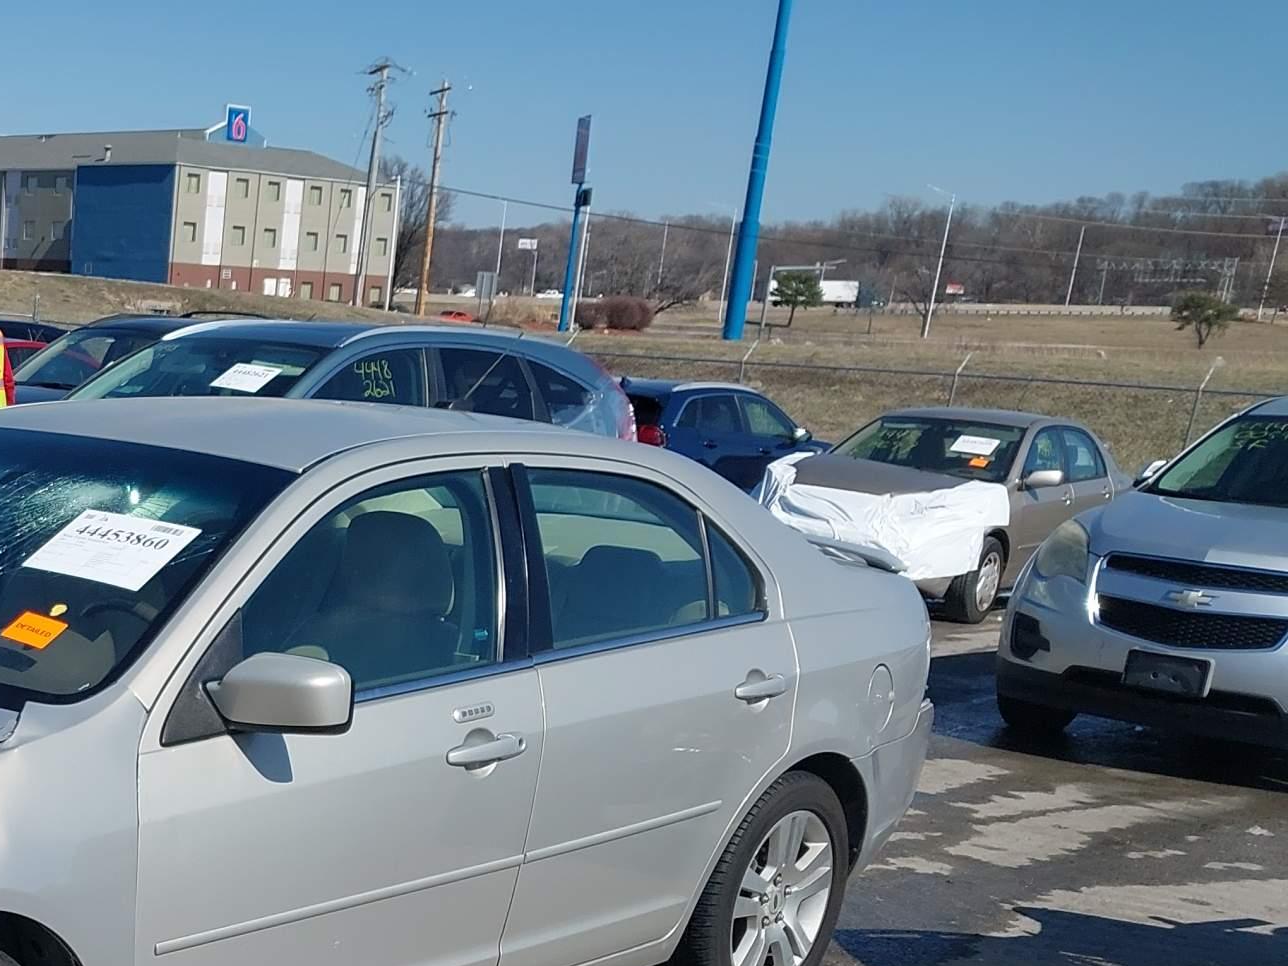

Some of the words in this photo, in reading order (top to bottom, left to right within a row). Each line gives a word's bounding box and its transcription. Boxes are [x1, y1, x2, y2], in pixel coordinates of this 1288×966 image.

[232, 112, 246, 140] 6
[354, 360, 392, 380] 4448
[363, 380, 396, 398] 2621
[75, 524, 170, 551] 44453860
